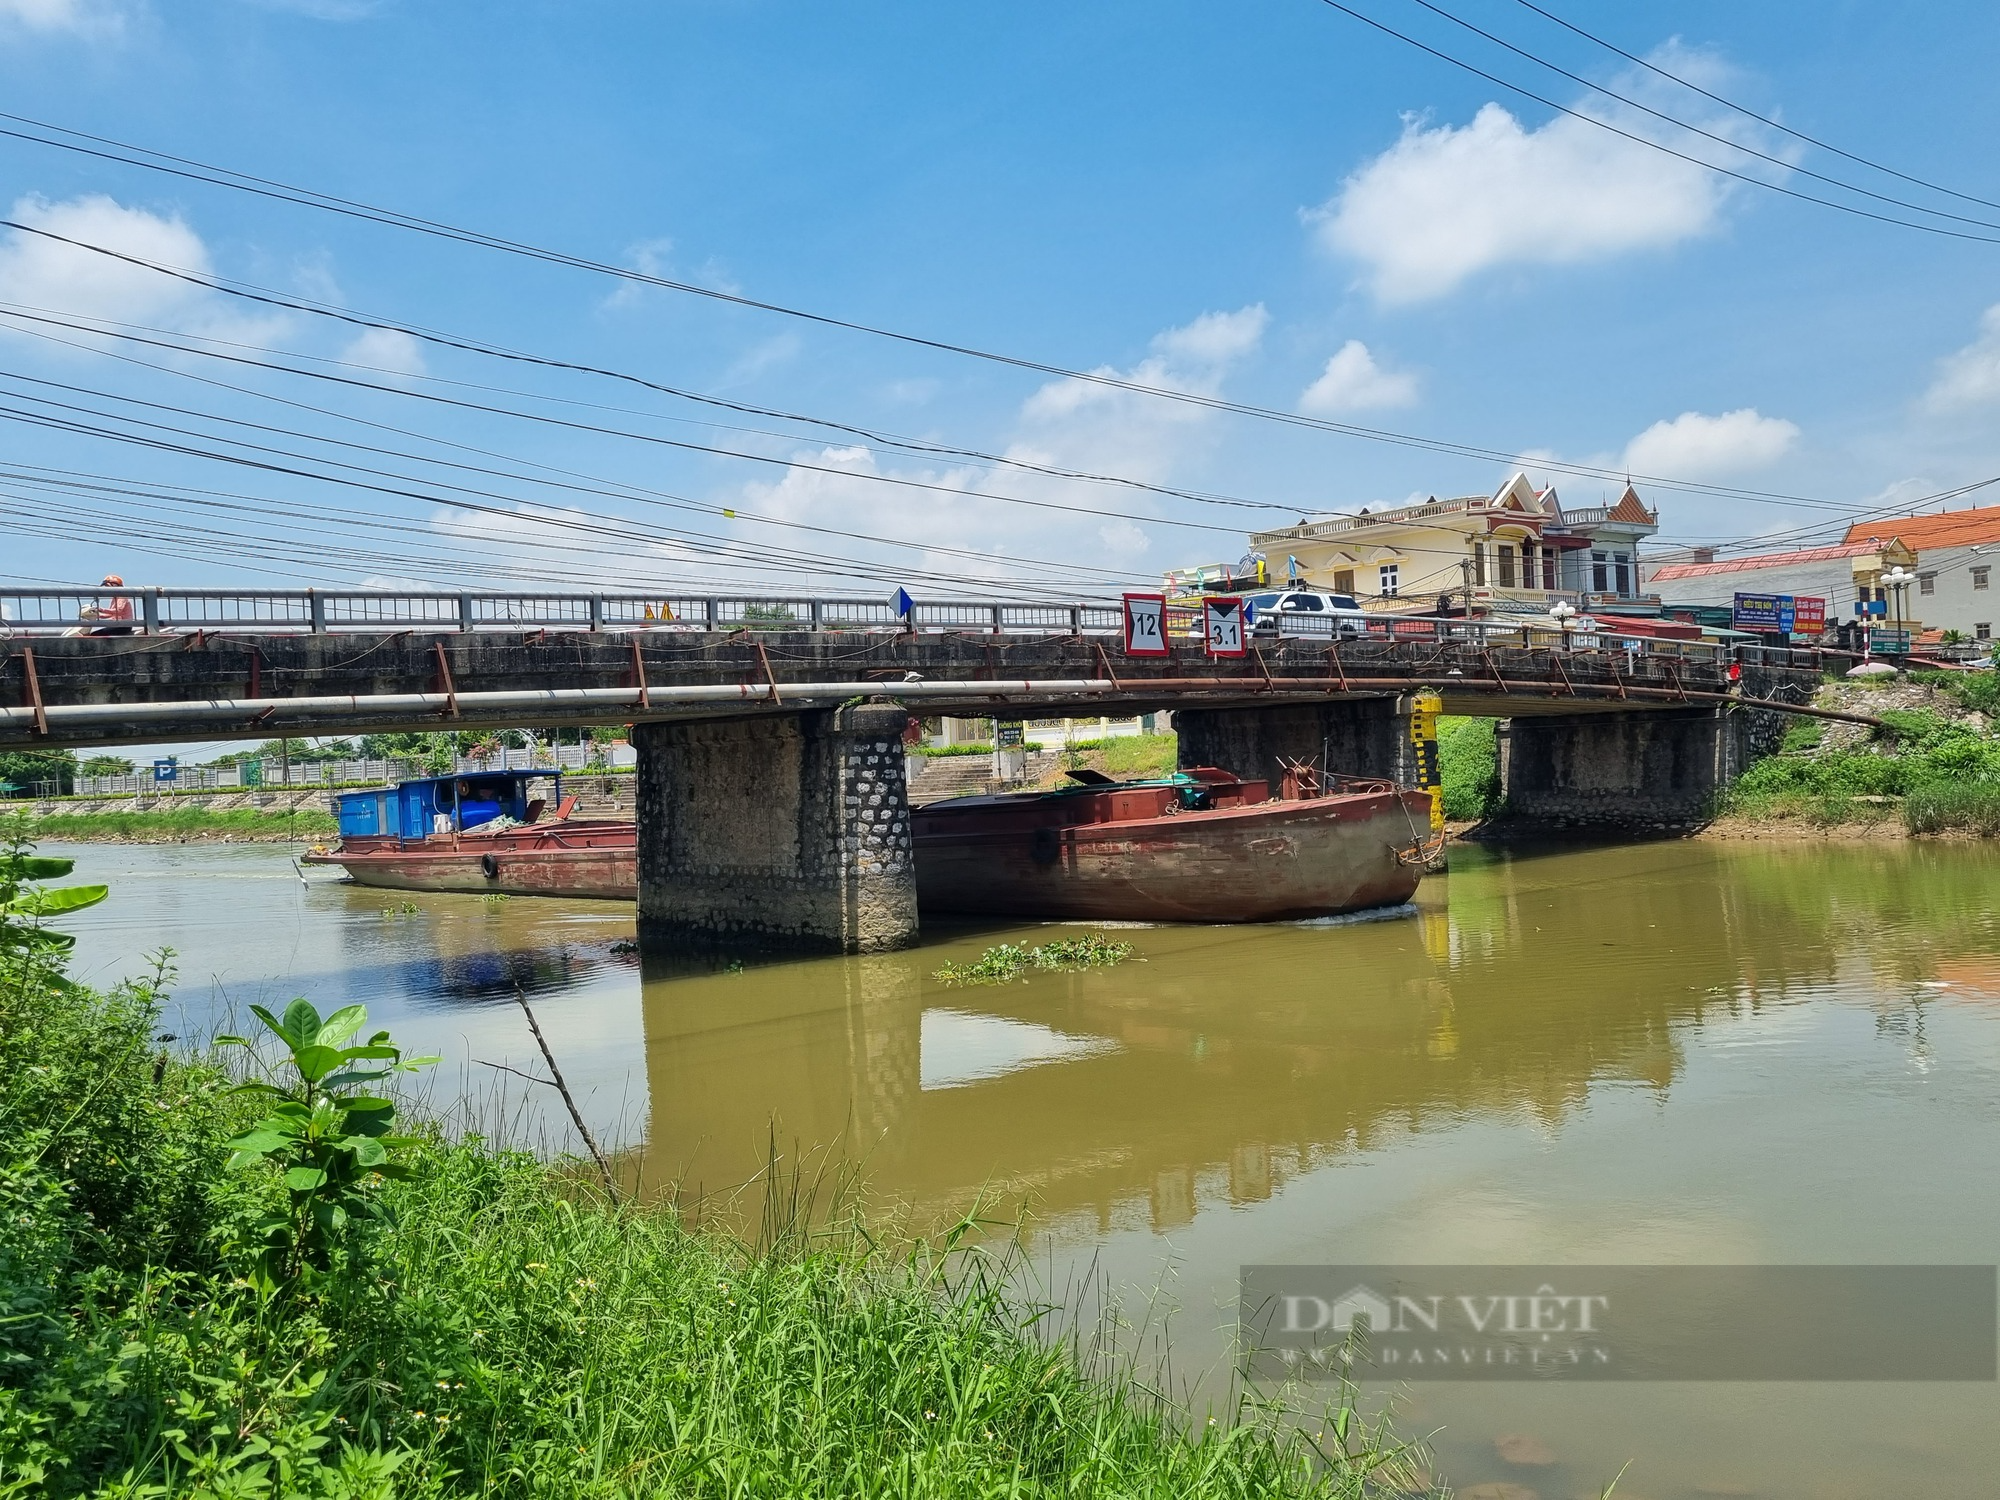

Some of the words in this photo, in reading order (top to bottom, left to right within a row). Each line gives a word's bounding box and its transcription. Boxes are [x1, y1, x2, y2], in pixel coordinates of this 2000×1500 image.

[1137, 613, 1156, 636] 12
[1213, 624, 1237, 645] 3.1
[159, 764, 172, 777] P
